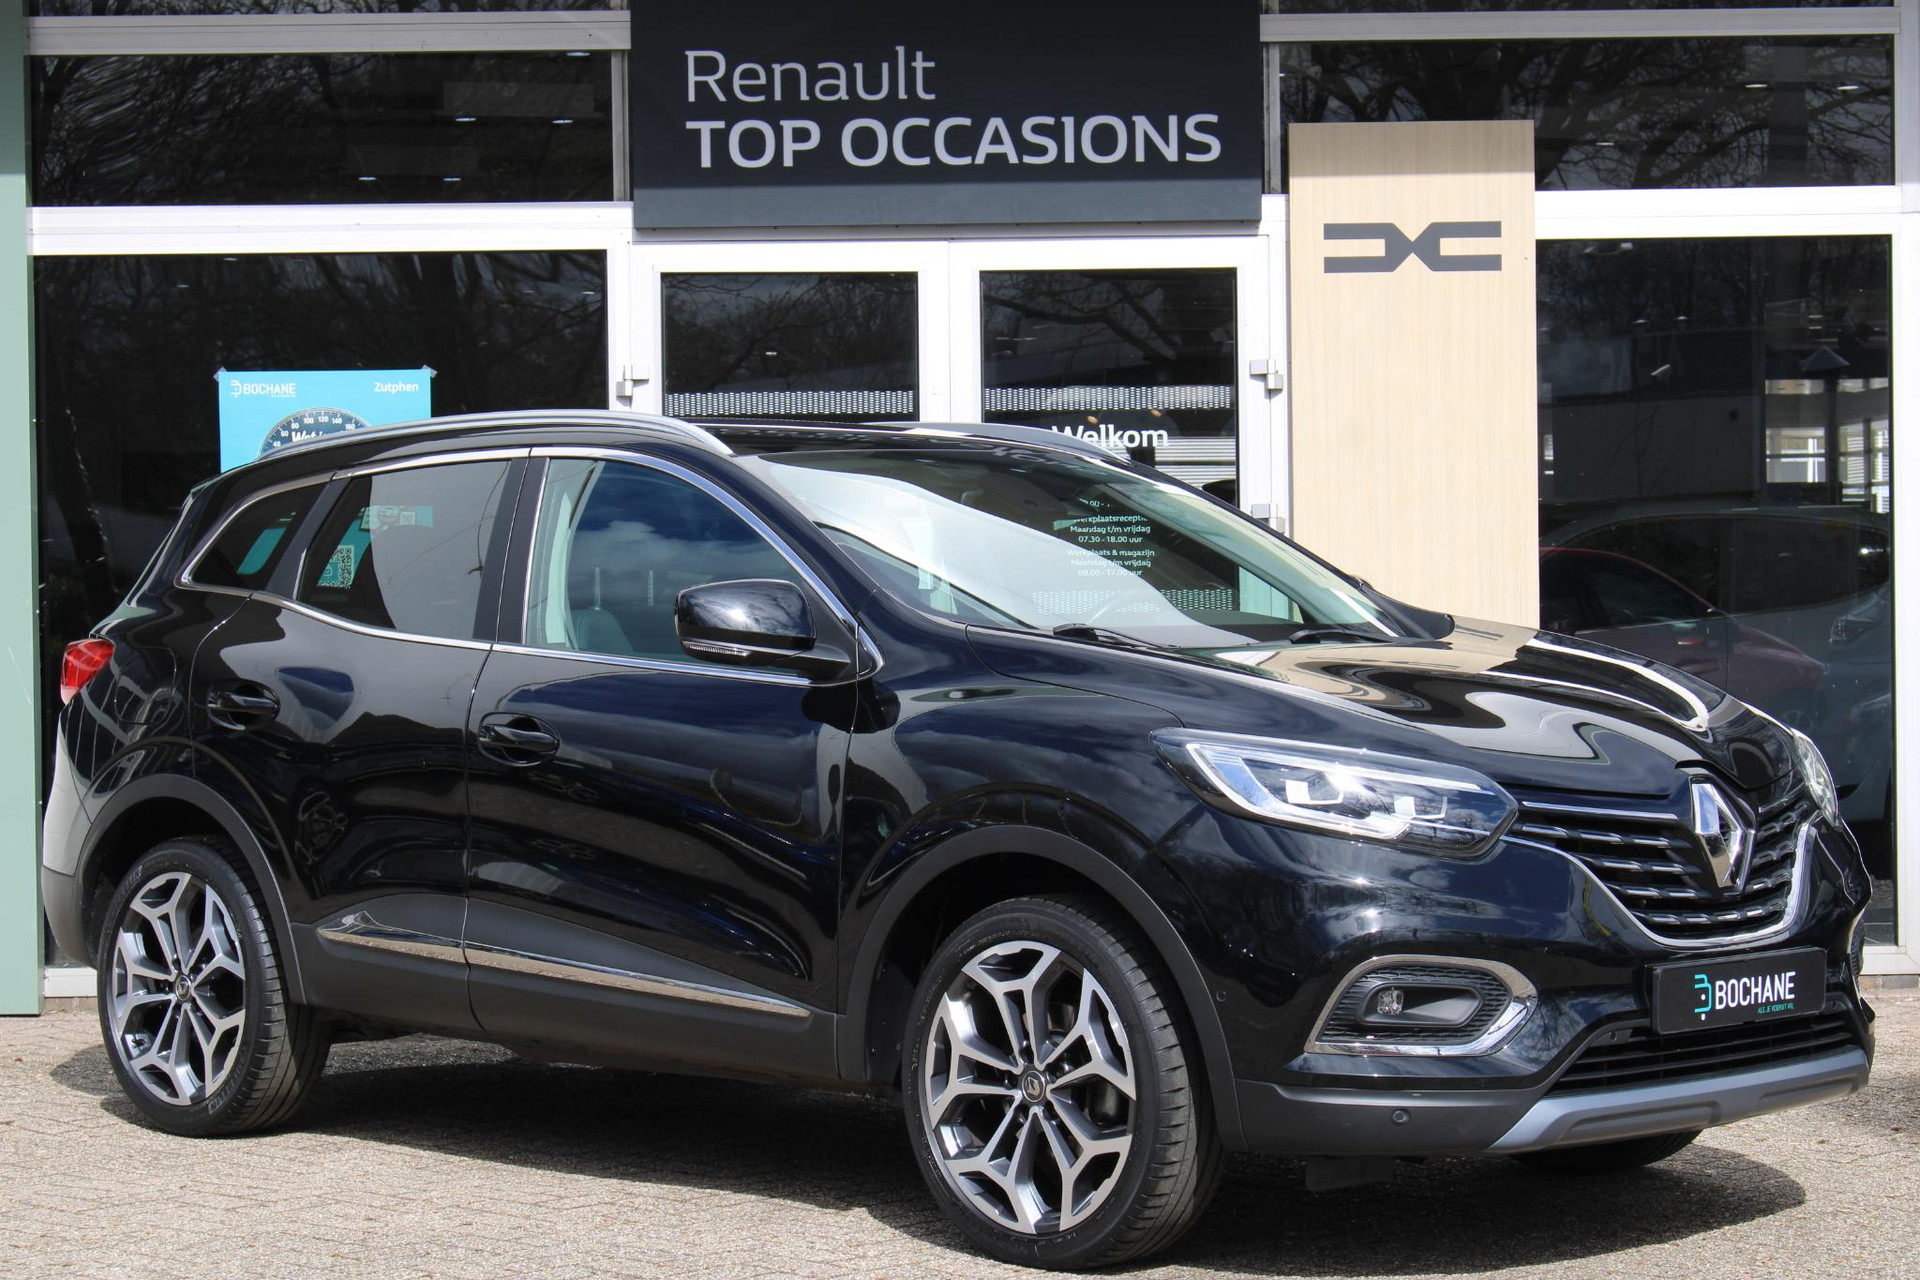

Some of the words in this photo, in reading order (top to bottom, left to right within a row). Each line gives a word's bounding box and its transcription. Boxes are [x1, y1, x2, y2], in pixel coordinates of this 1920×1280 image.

[685, 46, 936, 103] Renault
[686, 119, 820, 168] TOP
[841, 113, 1222, 168] OCCASIONS
[243, 383, 296, 395] BOCHANE
[374, 381, 419, 394] Zutphen
[1052, 424, 1168, 447] Welkom
[1070, 525, 1106, 536] Maandag
[1107, 526, 1122, 535] t/m
[1123, 524, 1151, 536] vrijdag
[1120, 548, 1155, 557] magazijn
[1124, 559, 1152, 568] vrijdag
[1716, 971, 1796, 1010] BOCHANE
